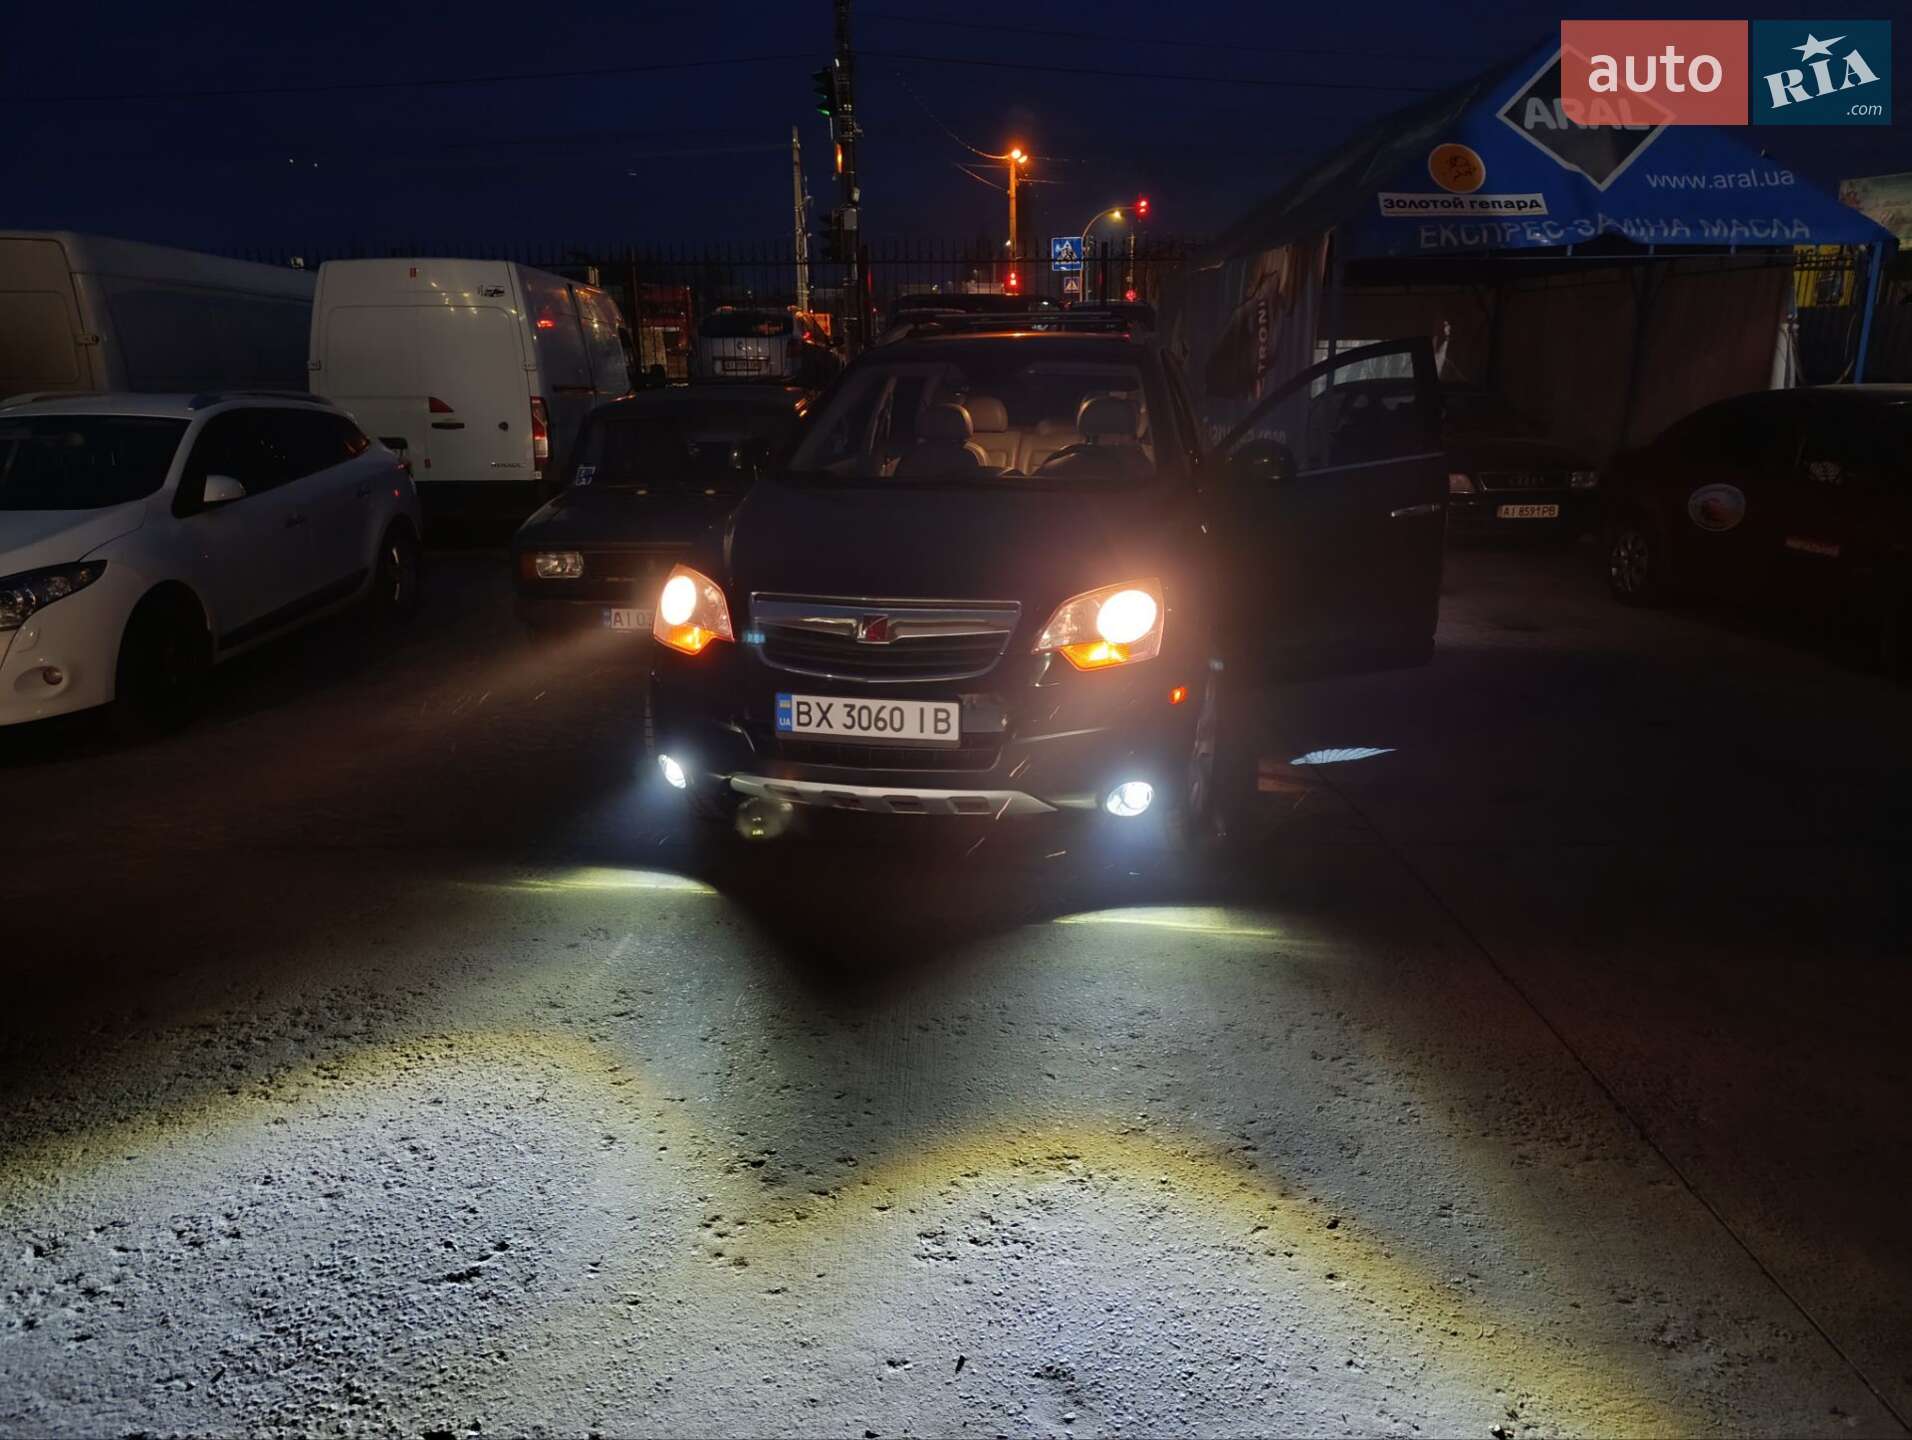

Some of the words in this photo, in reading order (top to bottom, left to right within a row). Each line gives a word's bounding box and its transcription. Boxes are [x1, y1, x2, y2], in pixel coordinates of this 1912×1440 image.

[1646, 168, 1795, 189] www.aral.ua
[796, 701, 834, 729] BX
[842, 703, 905, 733] 3060
[919, 707, 951, 735] IB
